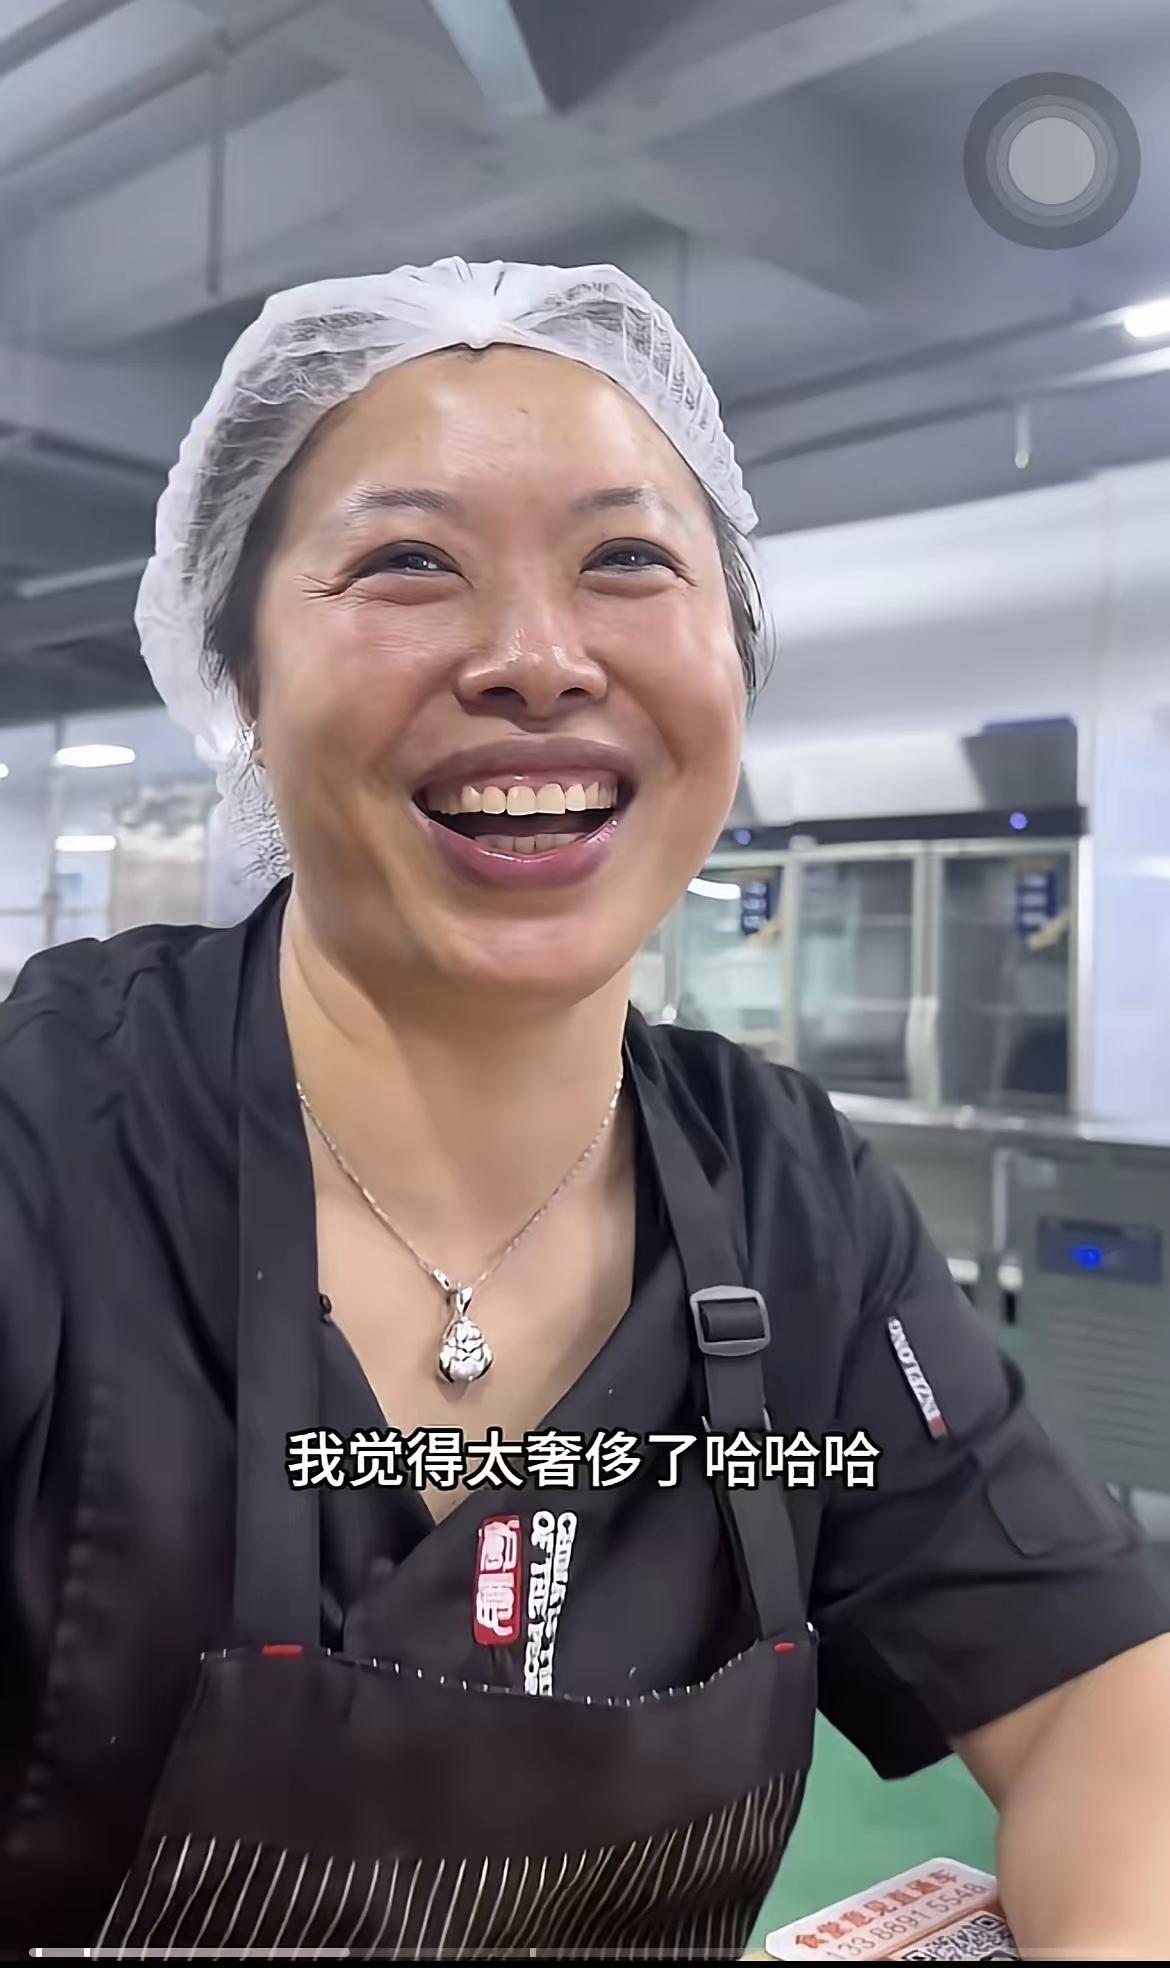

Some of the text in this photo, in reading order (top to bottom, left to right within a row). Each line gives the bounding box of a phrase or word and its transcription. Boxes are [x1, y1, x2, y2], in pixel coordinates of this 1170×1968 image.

[532, 1511, 555, 1552] OF
[529, 1558, 552, 1620] THE
[826, 1882, 987, 1961] 133 8891 5548
